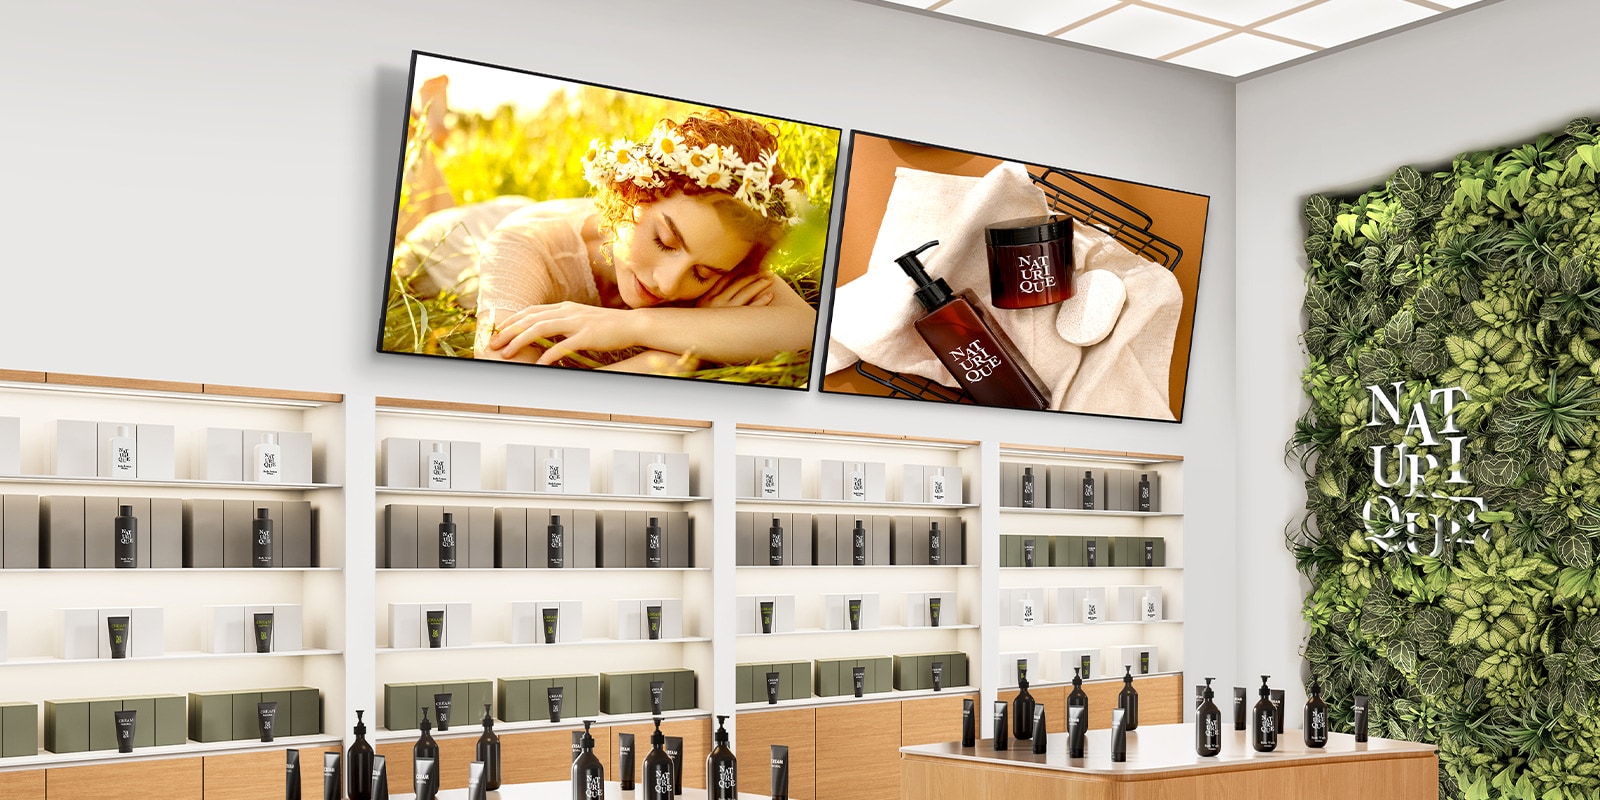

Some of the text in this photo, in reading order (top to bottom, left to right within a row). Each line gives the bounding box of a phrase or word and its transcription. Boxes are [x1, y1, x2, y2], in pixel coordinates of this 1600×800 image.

[1018, 255, 1049, 271] NAT
[1021, 265, 1050, 280] URI
[1019, 276, 1056, 293] QUE
[949, 339, 981, 361] NAT
[960, 348, 990, 371] URI
[965, 356, 1001, 384] QUE
[1366, 381, 1473, 446] NAT
[1369, 436, 1473, 499] URI
[719, 765, 733, 775] NAT
[587, 775, 600, 784] NAT
[656, 771, 670, 781] NAT
[720, 773, 733, 781] URI
[587, 782, 600, 790] URI
[657, 778, 670, 786] URI
[718, 780, 736, 789] QUE
[586, 789, 603, 798] QUE
[655, 785, 672, 794] QUE
